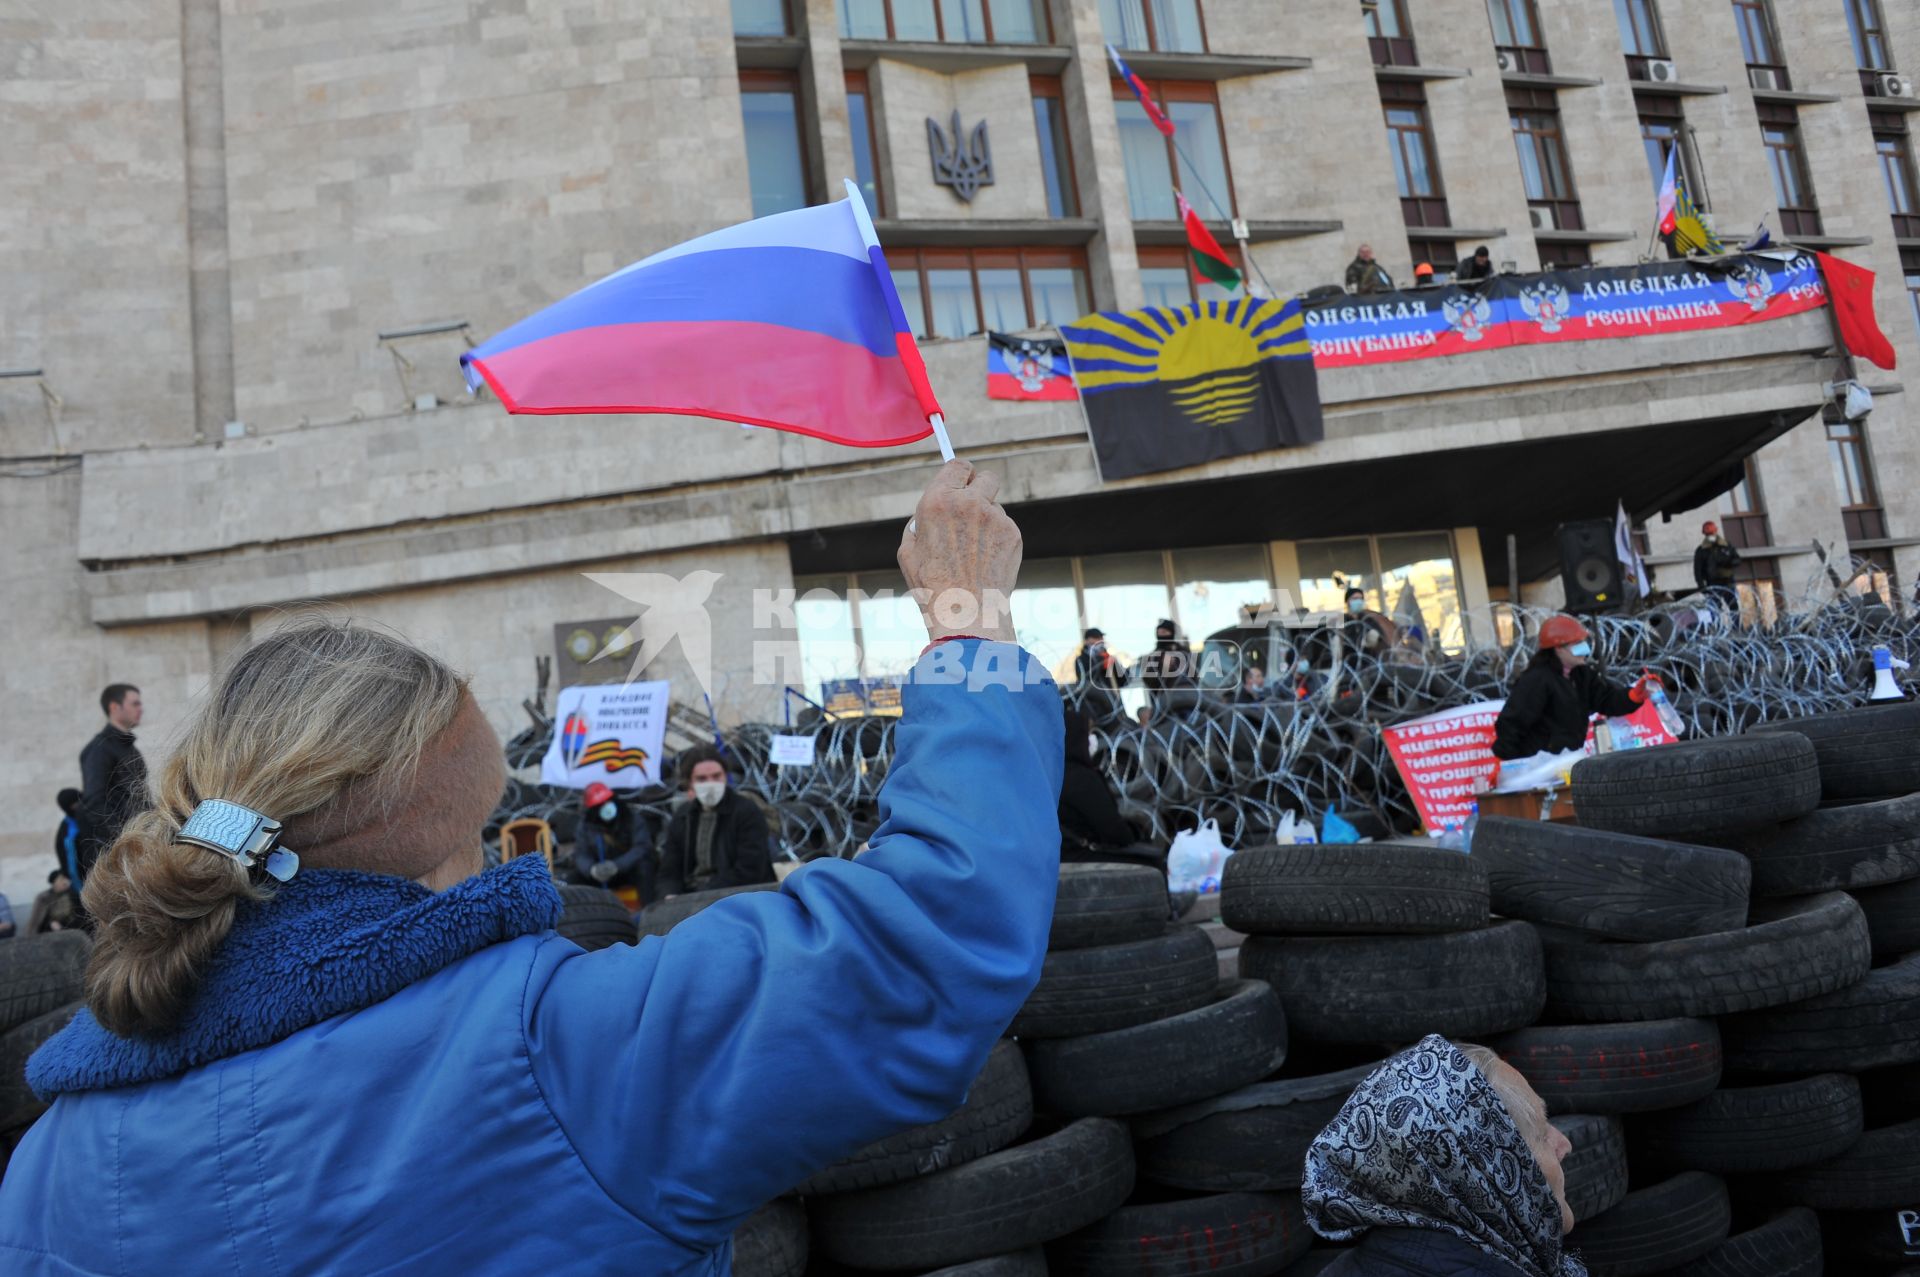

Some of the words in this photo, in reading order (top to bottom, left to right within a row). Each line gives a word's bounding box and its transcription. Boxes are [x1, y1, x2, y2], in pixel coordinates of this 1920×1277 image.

[1582, 271, 1712, 301] ДОНЕЦКАЯ
[1305, 300, 1429, 327] ОНЕЦКАЯ
[1586, 299, 1722, 328] РЕСПУБЛИКА
[1311, 328, 1437, 358] ЕСПУБЛИКА
